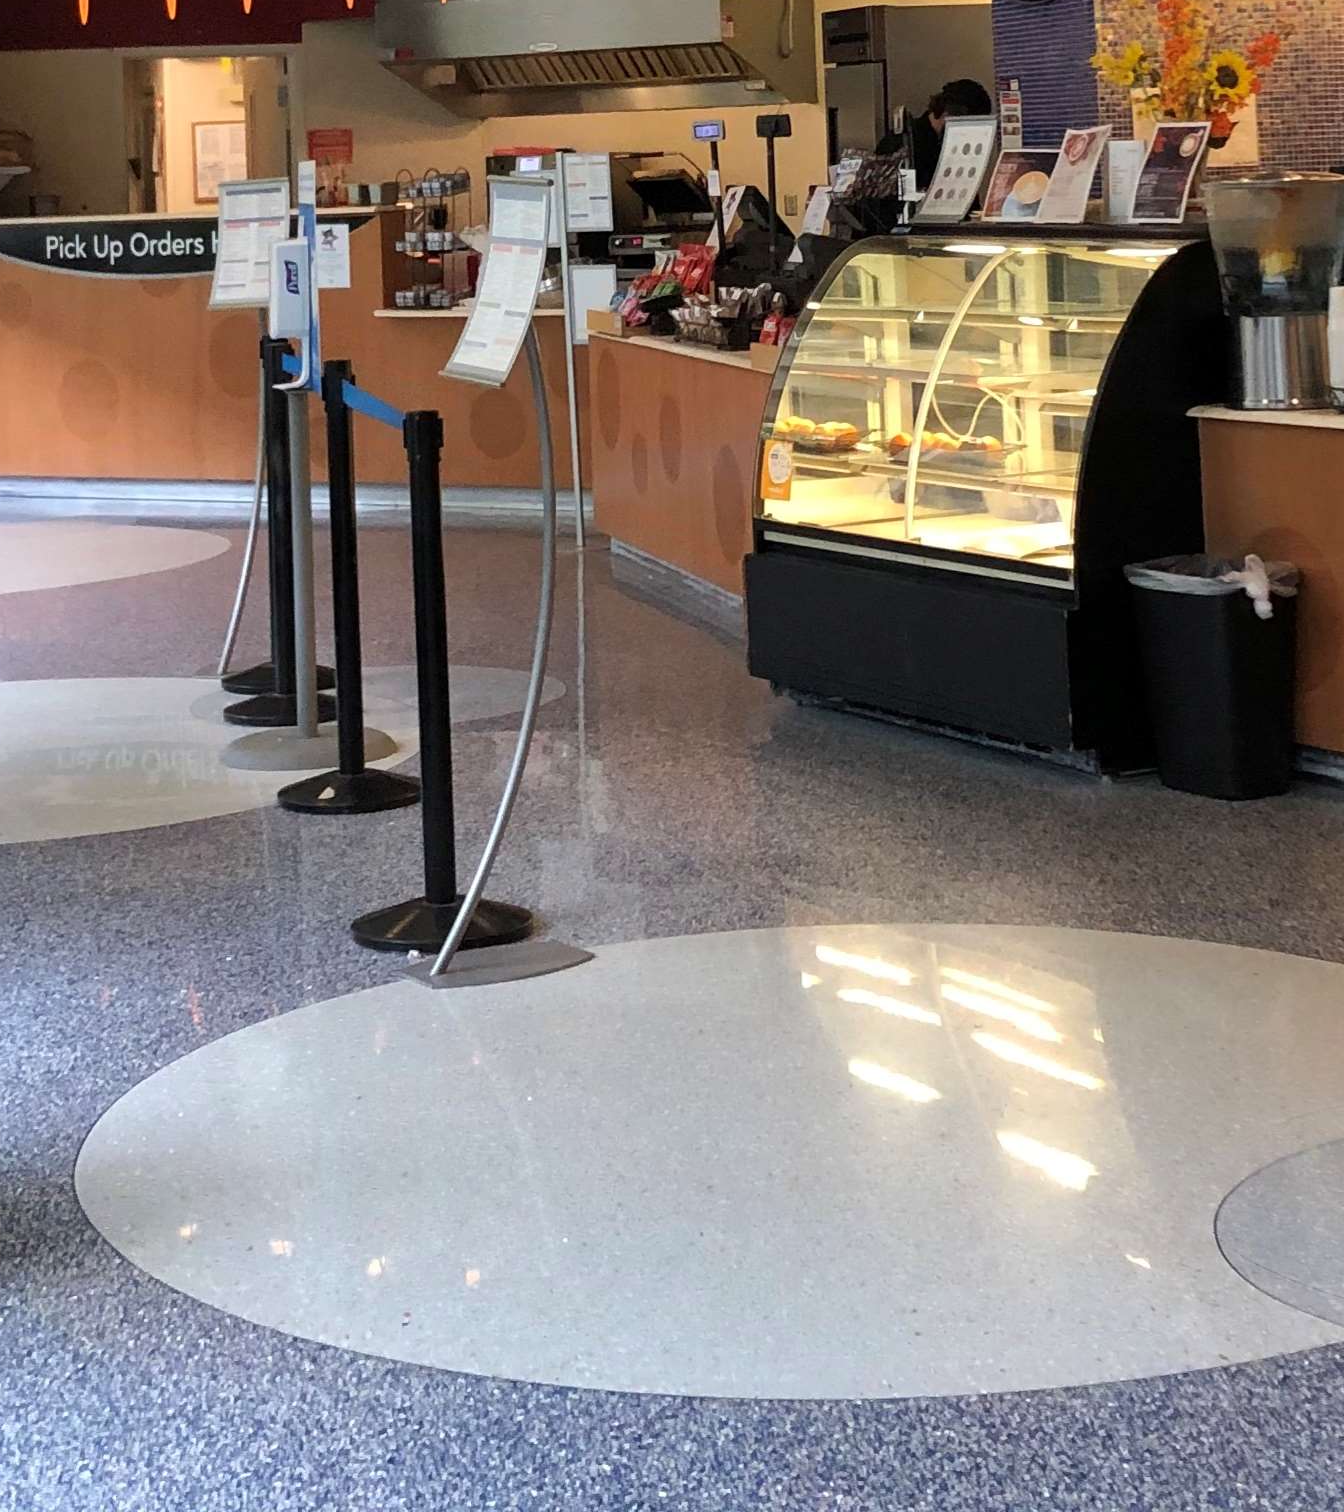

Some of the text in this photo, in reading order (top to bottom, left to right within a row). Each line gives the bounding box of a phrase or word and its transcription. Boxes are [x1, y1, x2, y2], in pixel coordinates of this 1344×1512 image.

[45, 234, 87, 260] Pick
[93, 234, 123, 265] Up
[129, 230, 205, 258] Orders
